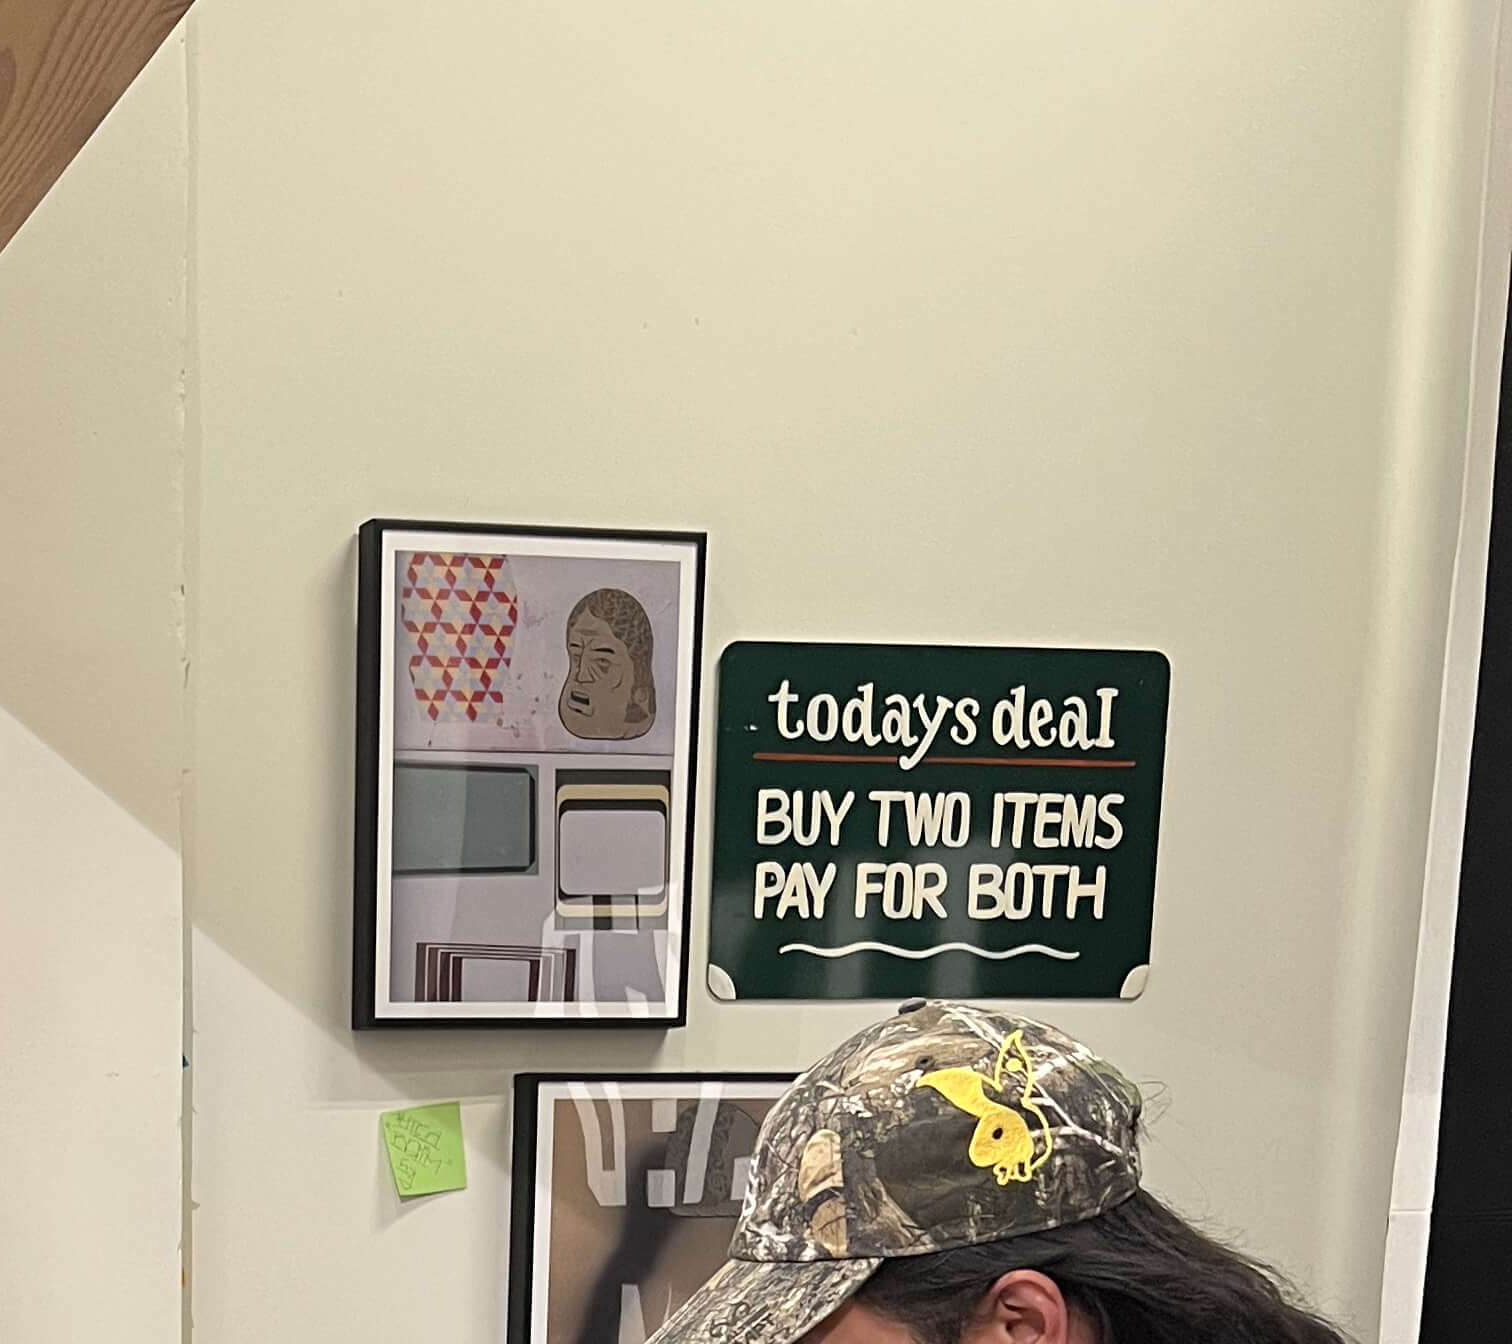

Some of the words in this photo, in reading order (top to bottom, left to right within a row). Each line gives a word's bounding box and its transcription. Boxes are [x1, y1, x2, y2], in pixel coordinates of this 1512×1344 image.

[768, 680, 980, 770] todays
[992, 685, 1119, 750] deal
[756, 789, 855, 846] BUY
[869, 791, 970, 848] TWO
[991, 792, 1125, 850] ITEMS
[754, 861, 837, 919] PAY
[855, 863, 948, 919] FOR
[968, 863, 1106, 919] BOTH
